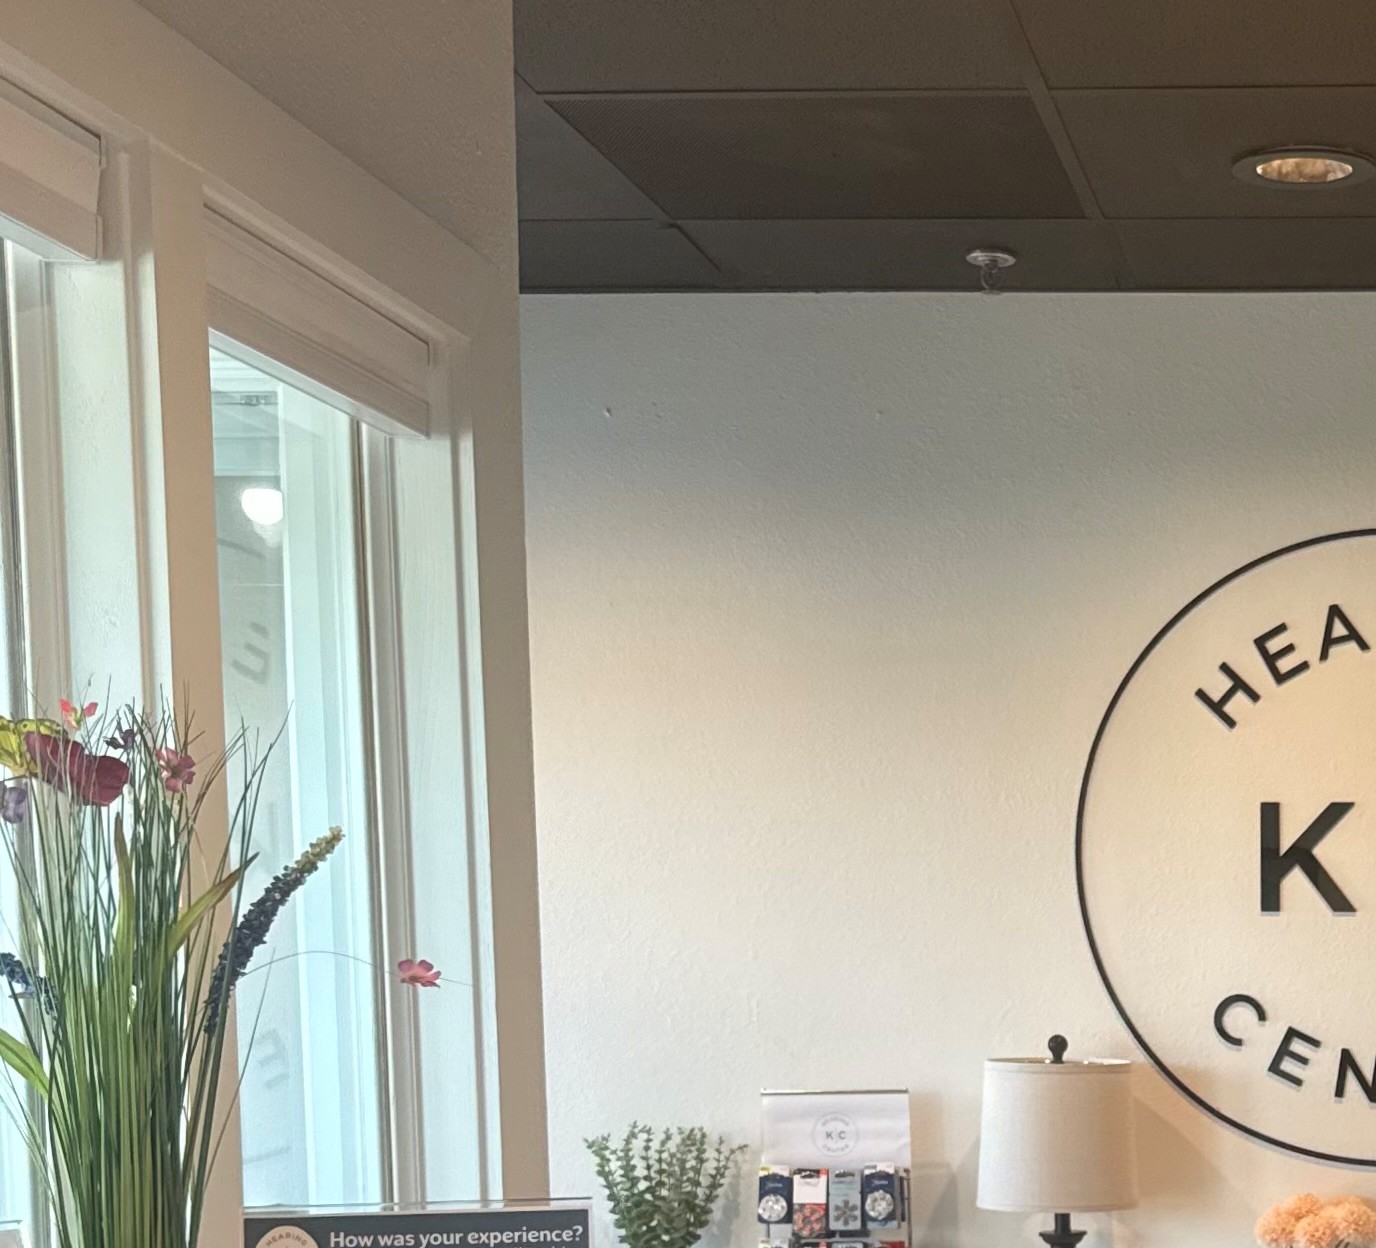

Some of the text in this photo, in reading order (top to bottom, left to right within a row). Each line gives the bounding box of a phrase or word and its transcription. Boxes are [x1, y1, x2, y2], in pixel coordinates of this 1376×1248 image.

[329, 1231, 374, 1248] How
[378, 1234, 415, 1247] was
[467, 1225, 583, 1248] experience?
